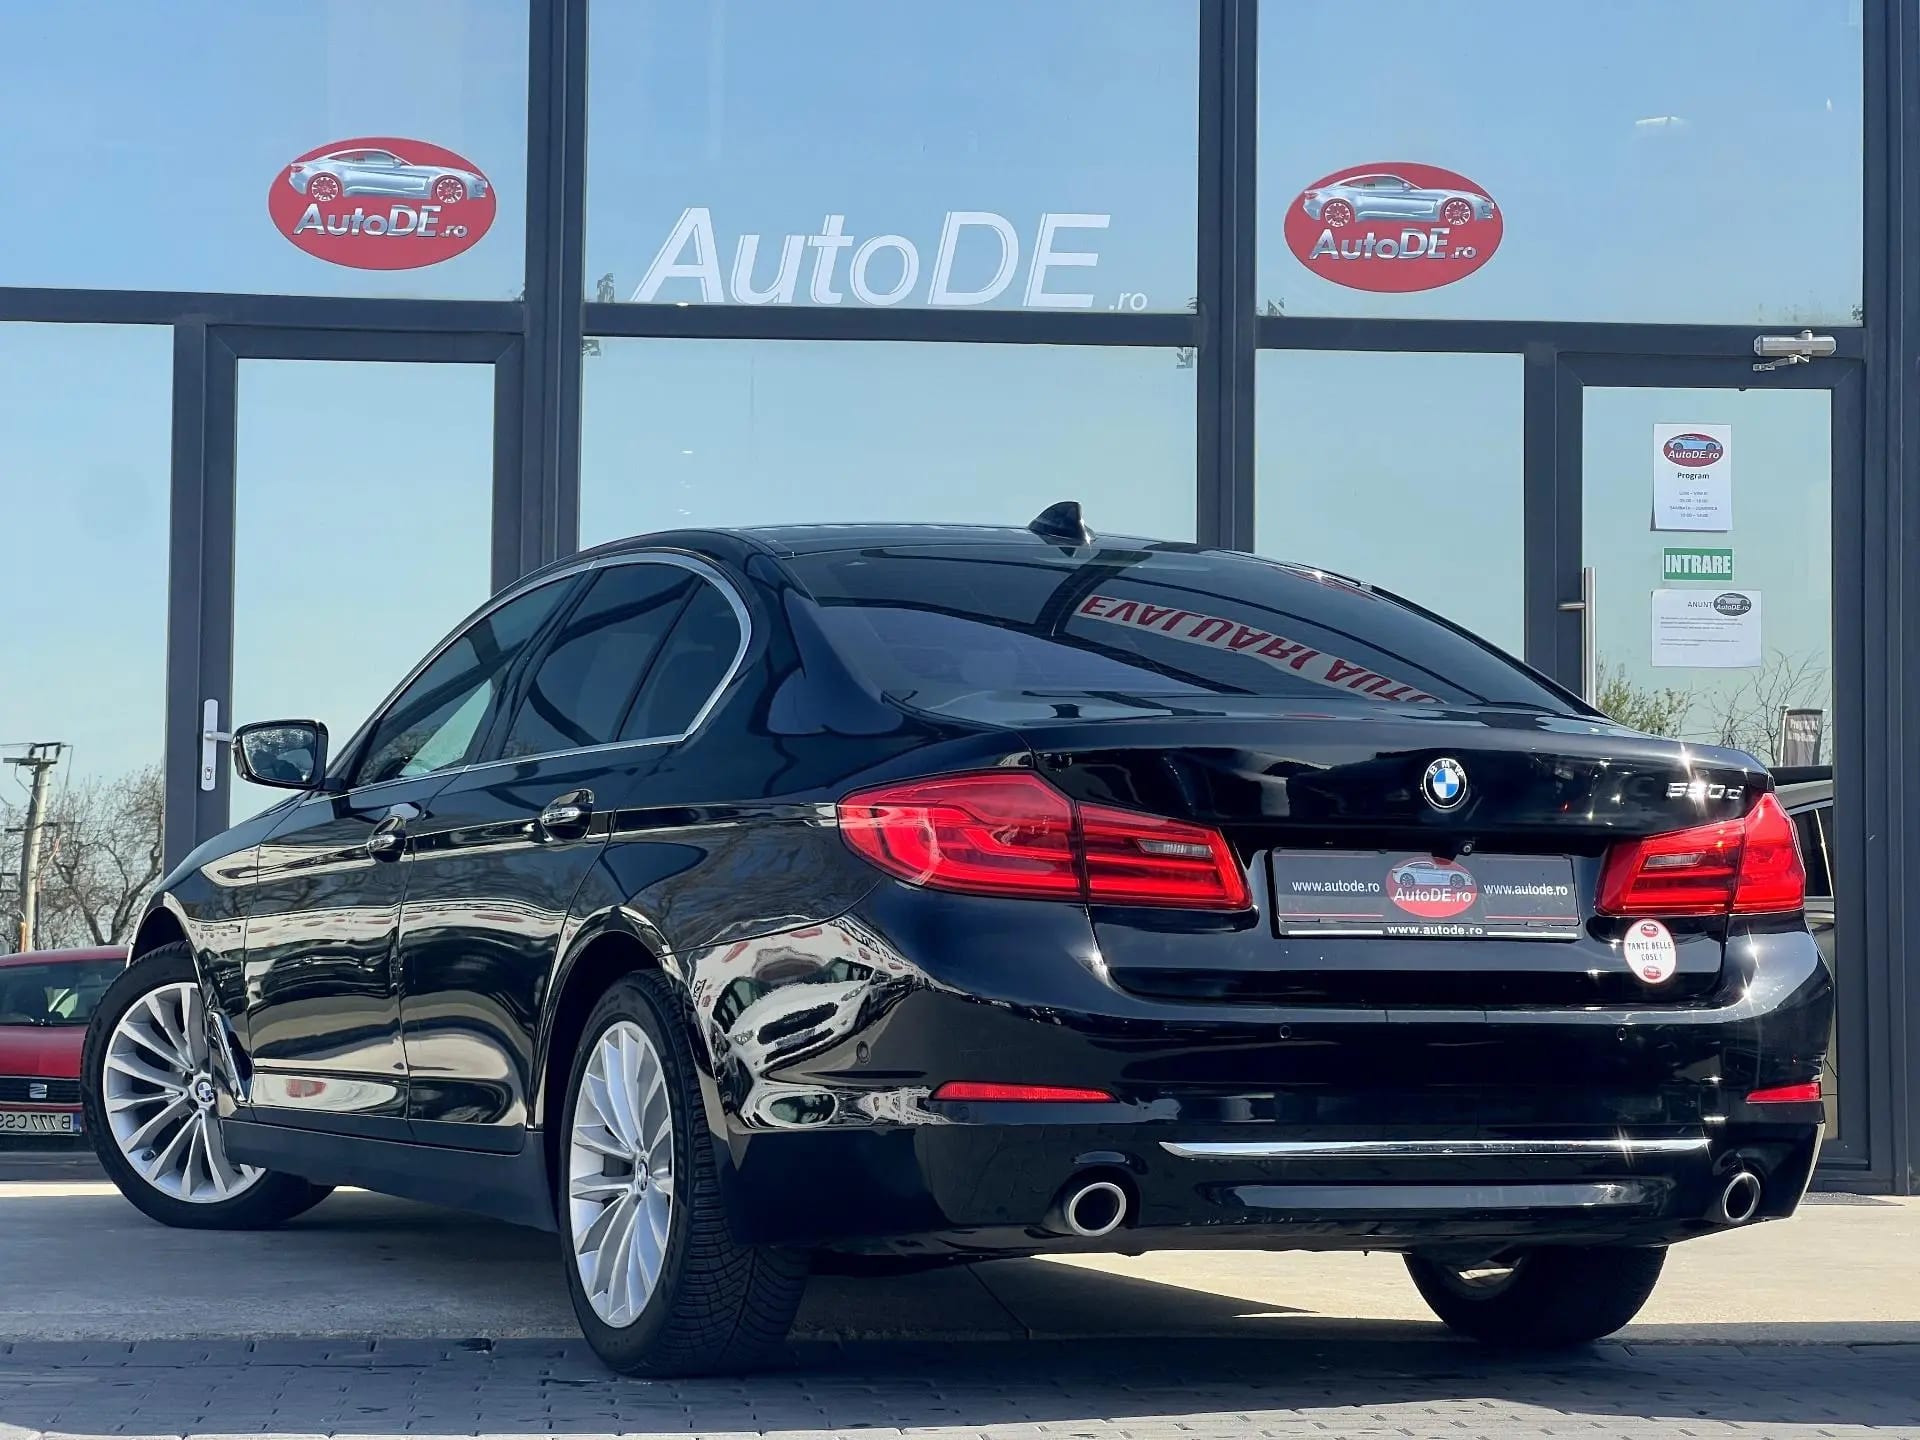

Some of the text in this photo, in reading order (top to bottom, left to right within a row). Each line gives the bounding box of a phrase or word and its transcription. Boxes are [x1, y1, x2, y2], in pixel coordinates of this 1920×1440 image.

[1667, 450, 1720, 459] AutoDE.ro
[1677, 472, 1710, 481] Program
[1665, 554, 1732, 574] INTRARE
[1429, 760, 1465, 777] BMW
[1292, 879, 1568, 903] www.autode.ro AutoDE.ro www.autode.ro
[1387, 924, 1483, 936] www.autode.ro
[1652, 941, 1672, 950] BELLE
